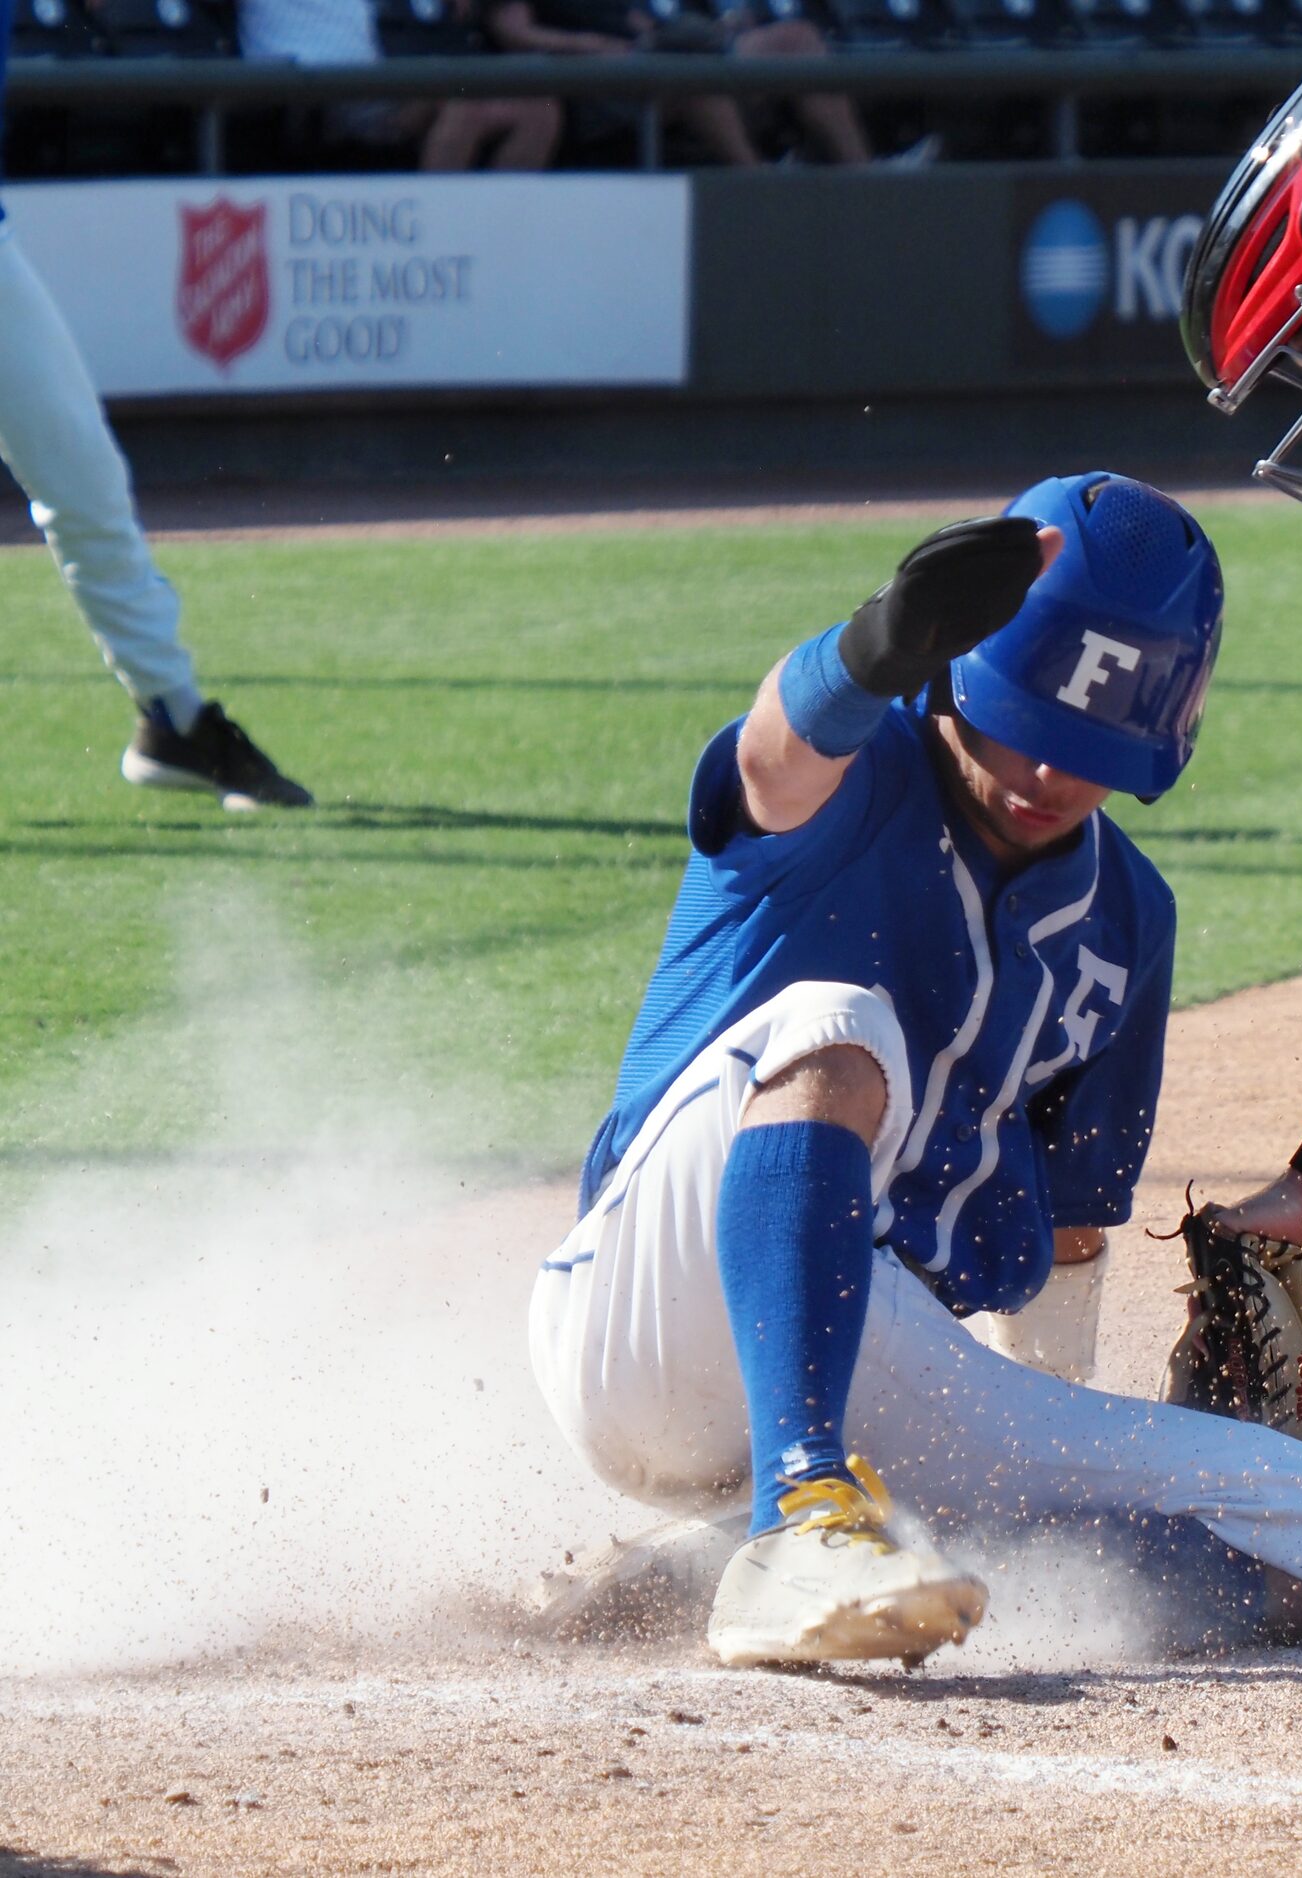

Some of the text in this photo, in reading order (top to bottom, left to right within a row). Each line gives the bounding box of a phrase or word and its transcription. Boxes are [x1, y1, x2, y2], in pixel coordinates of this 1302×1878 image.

[288, 193, 417, 247] DOING
[286, 255, 476, 306] THE MOST
[284, 314, 405, 366] GOOD
[1056, 629, 1142, 711] F
